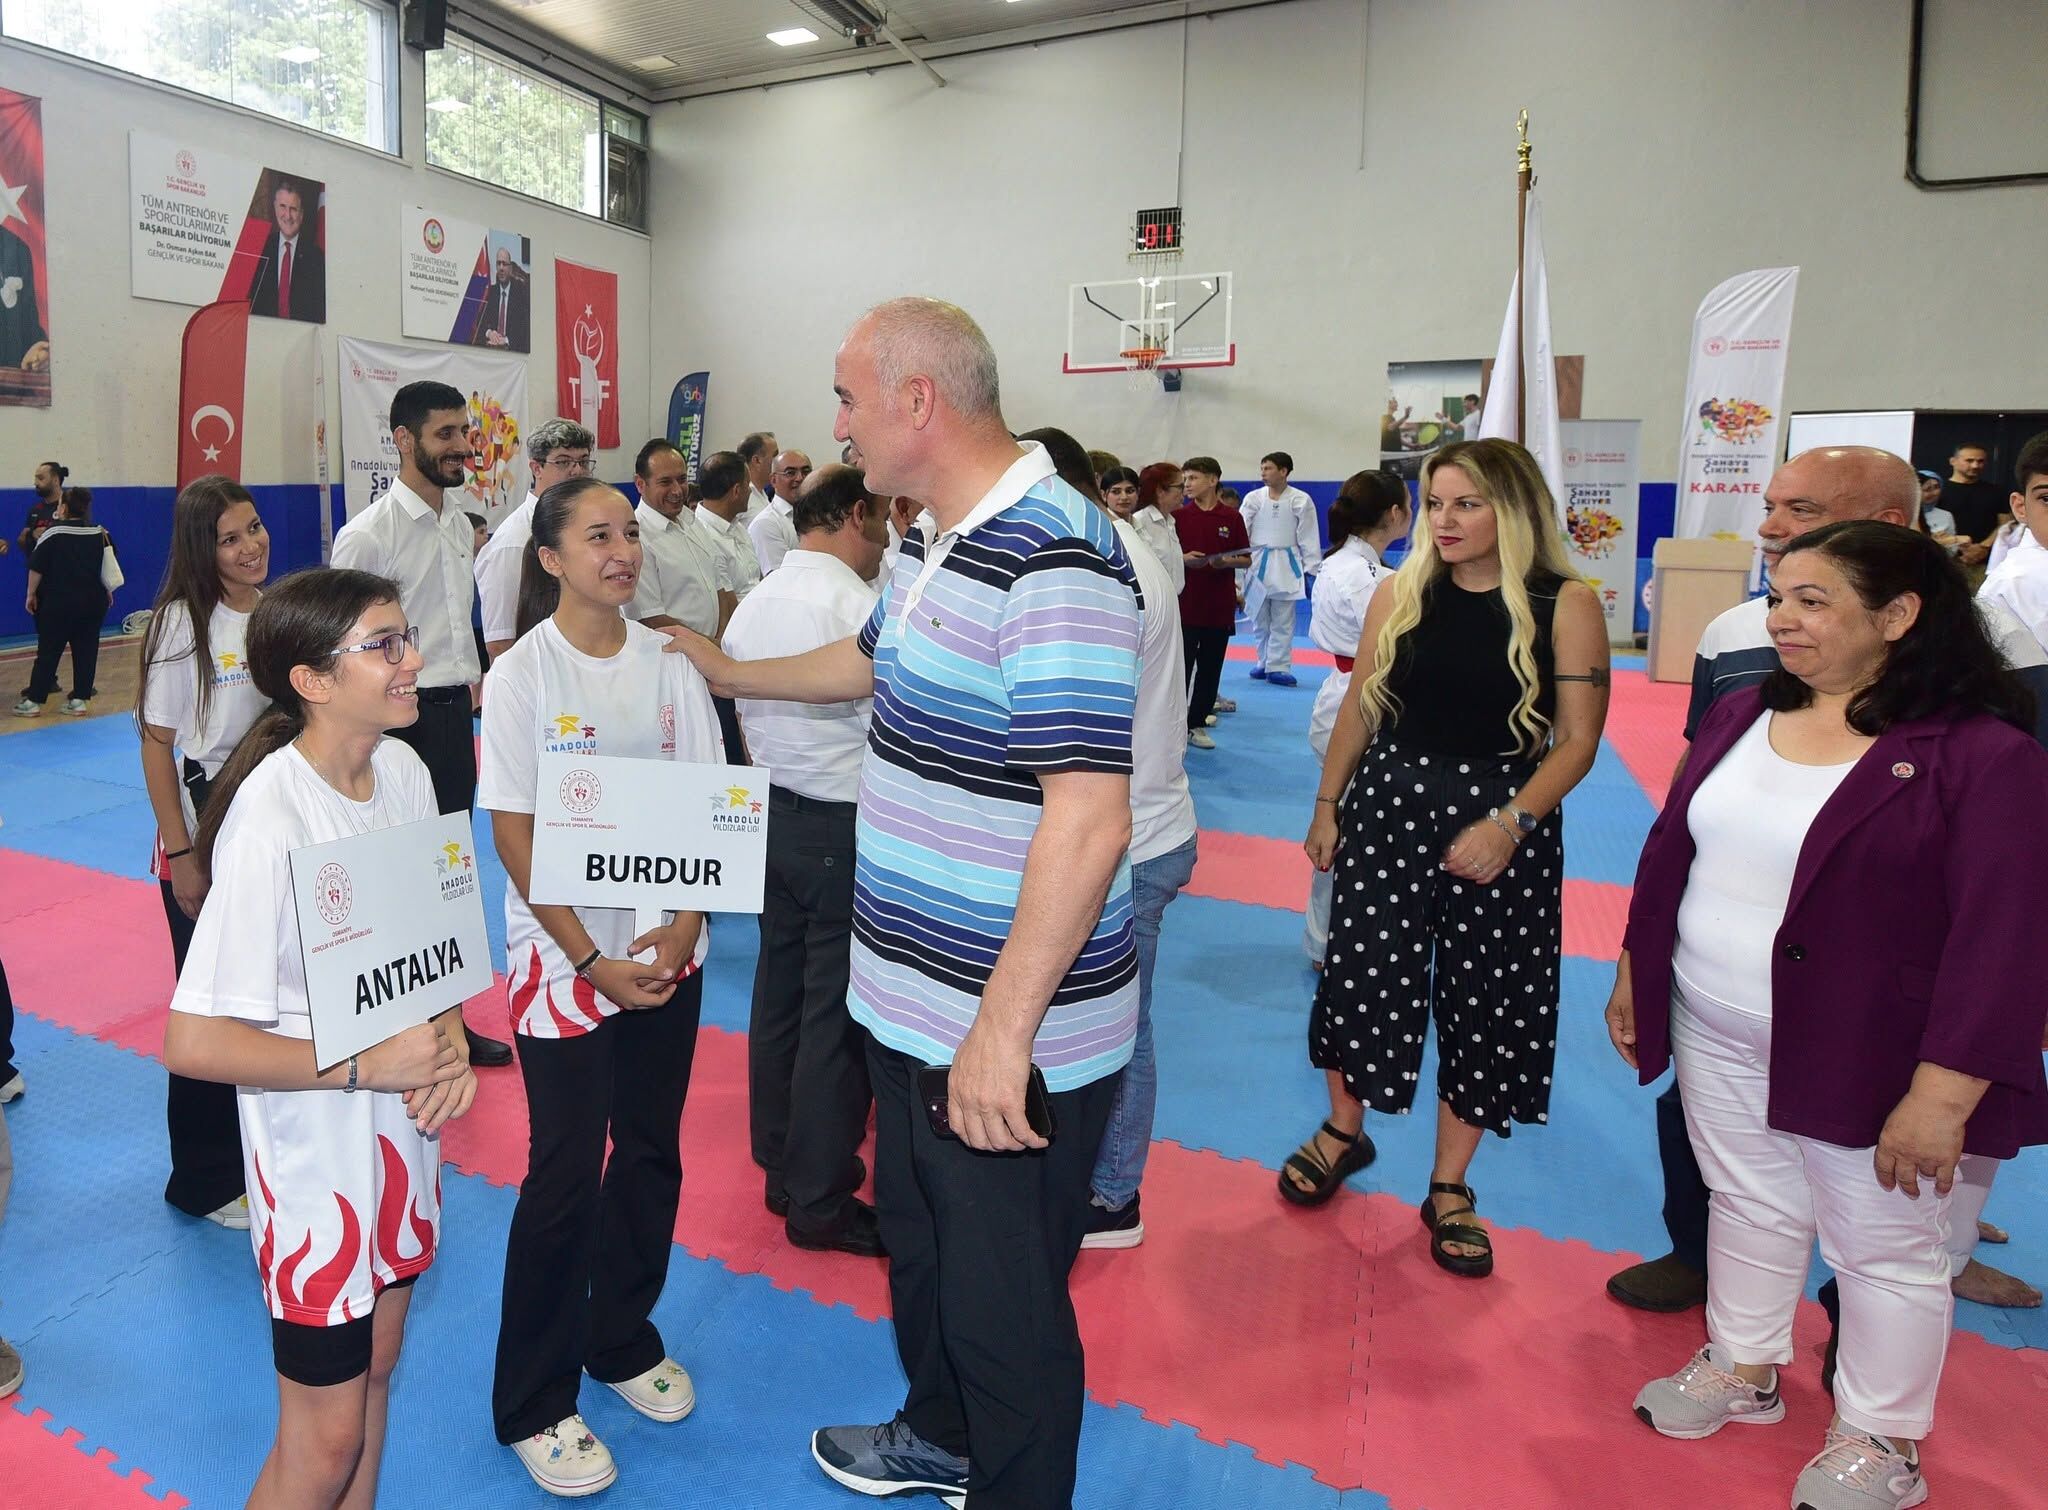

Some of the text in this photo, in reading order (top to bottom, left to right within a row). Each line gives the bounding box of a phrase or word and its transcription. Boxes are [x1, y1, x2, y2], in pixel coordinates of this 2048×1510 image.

[141, 194, 230, 224] TÜM ANTRENÖR VE
[144, 208, 227, 235] SPORCULARIMIZA
[139, 222, 232, 248] BAŞARILAR DİLİYORUM
[156, 241, 166, 249] Dr.
[166, 243, 187, 253] Osman
[205, 250, 217, 258] BAK
[185, 256, 201, 266] SPOR
[1690, 482, 1761, 493] KARATE
[712, 824, 746, 832] YILDIZLAR
[713, 814, 760, 824] ANADOLU
[585, 854, 722, 886] BURDUR
[441, 873, 472, 891] ANADOLU
[355, 937, 464, 1015] ANTALYA
